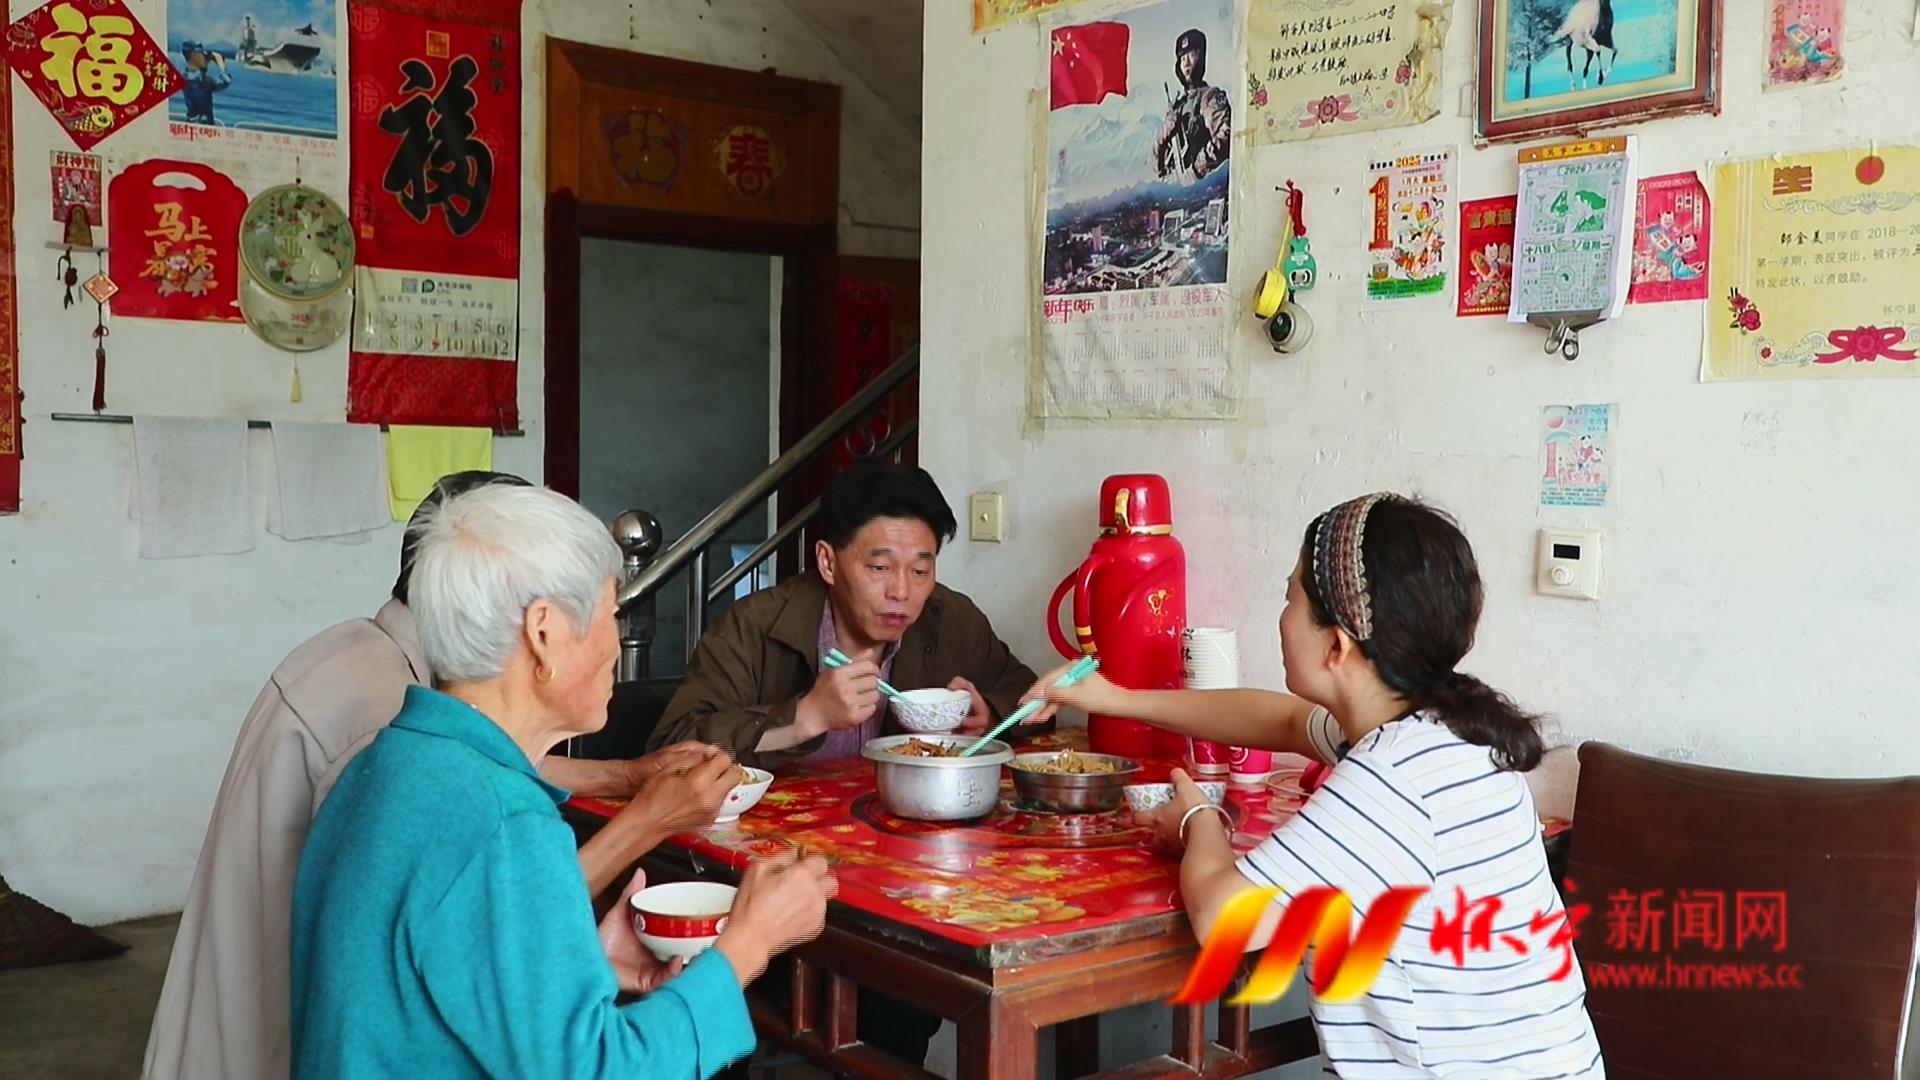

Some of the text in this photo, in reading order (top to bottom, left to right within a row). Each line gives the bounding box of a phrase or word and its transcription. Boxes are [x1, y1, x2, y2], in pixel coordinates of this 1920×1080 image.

[40, 3, 144, 105] 福
[377, 55, 494, 237] 福
[727, 131, 776, 196] 春
[1395, 155, 1422, 168] 2025
[1563, 164, 1587, 175] 2026
[143, 202, 213, 243] 马上
